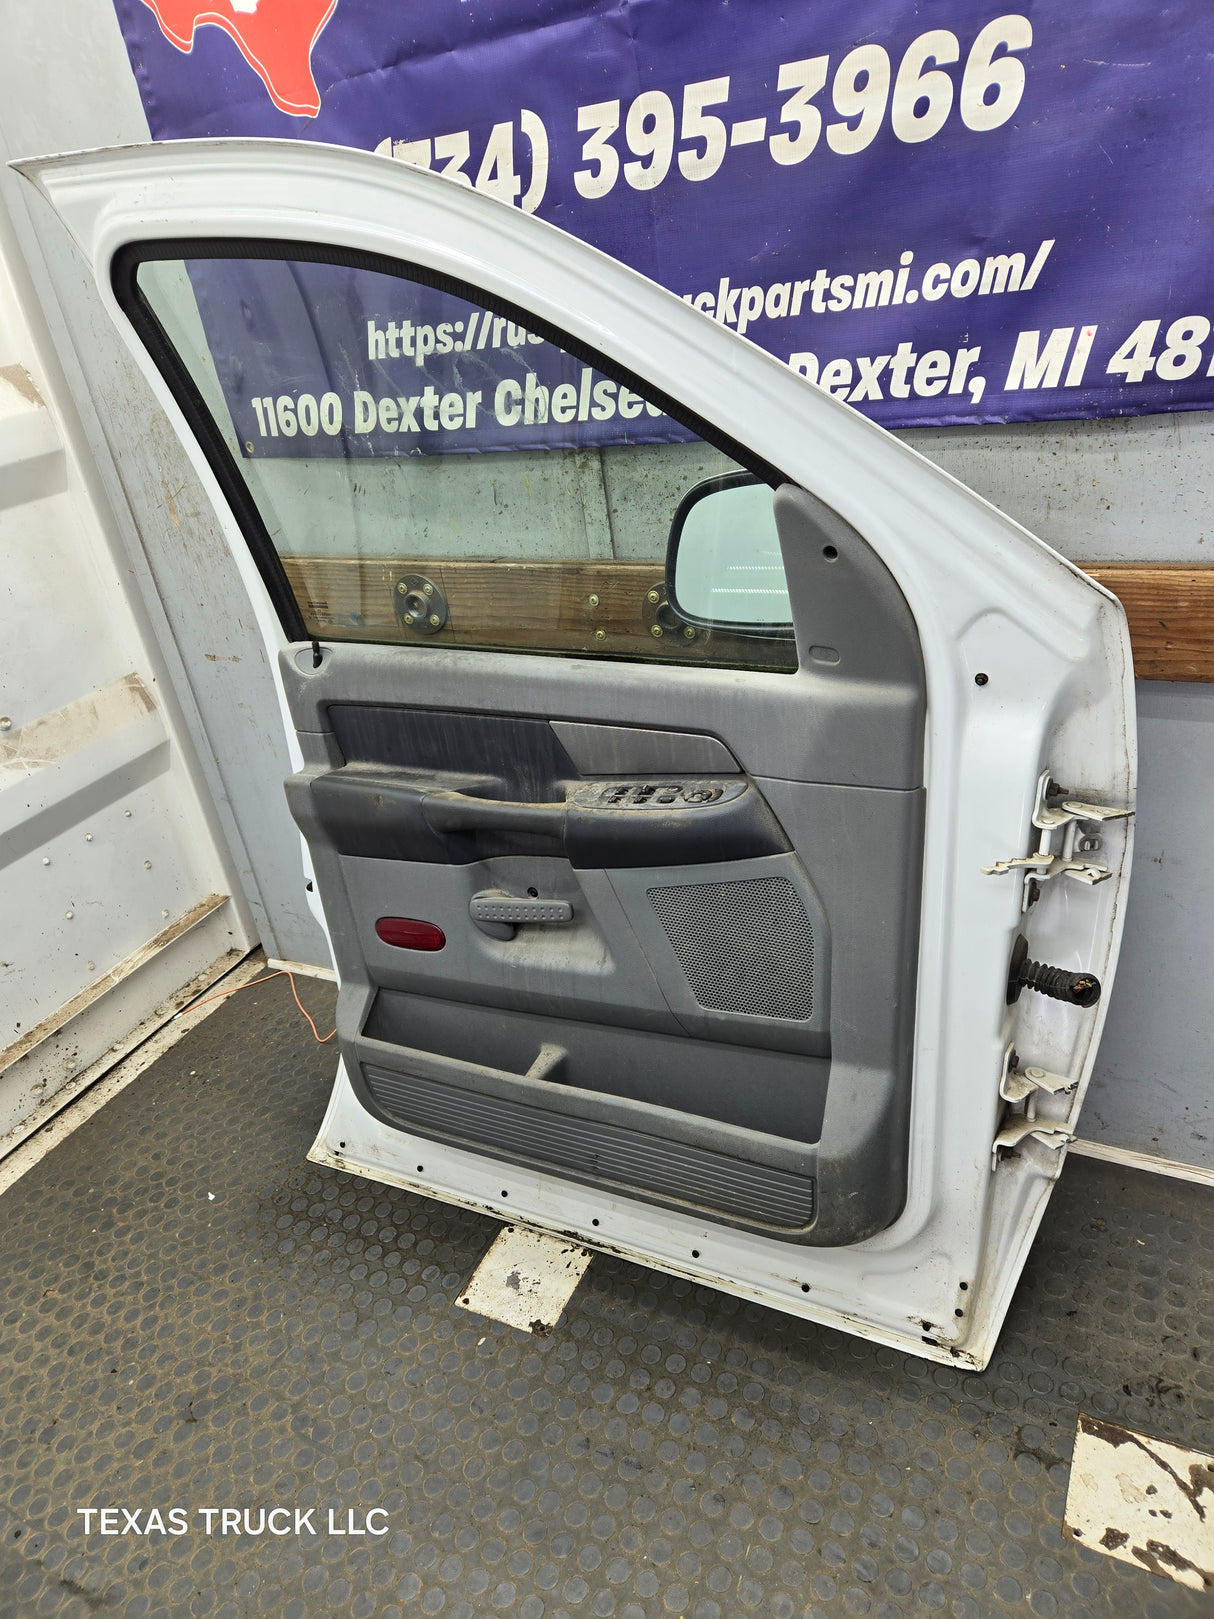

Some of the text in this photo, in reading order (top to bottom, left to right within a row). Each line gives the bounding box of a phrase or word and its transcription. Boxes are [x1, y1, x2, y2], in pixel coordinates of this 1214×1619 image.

[573, 14, 1034, 200] 395-3966
[682, 239, 1056, 334] ckpartsmi.com/
[251, 390, 343, 437] 11600
[353, 385, 482, 434] Dexter
[788, 341, 988, 405] Dexter,
[1003, 324, 1099, 391] MI
[1105, 315, 1214, 383] 48
